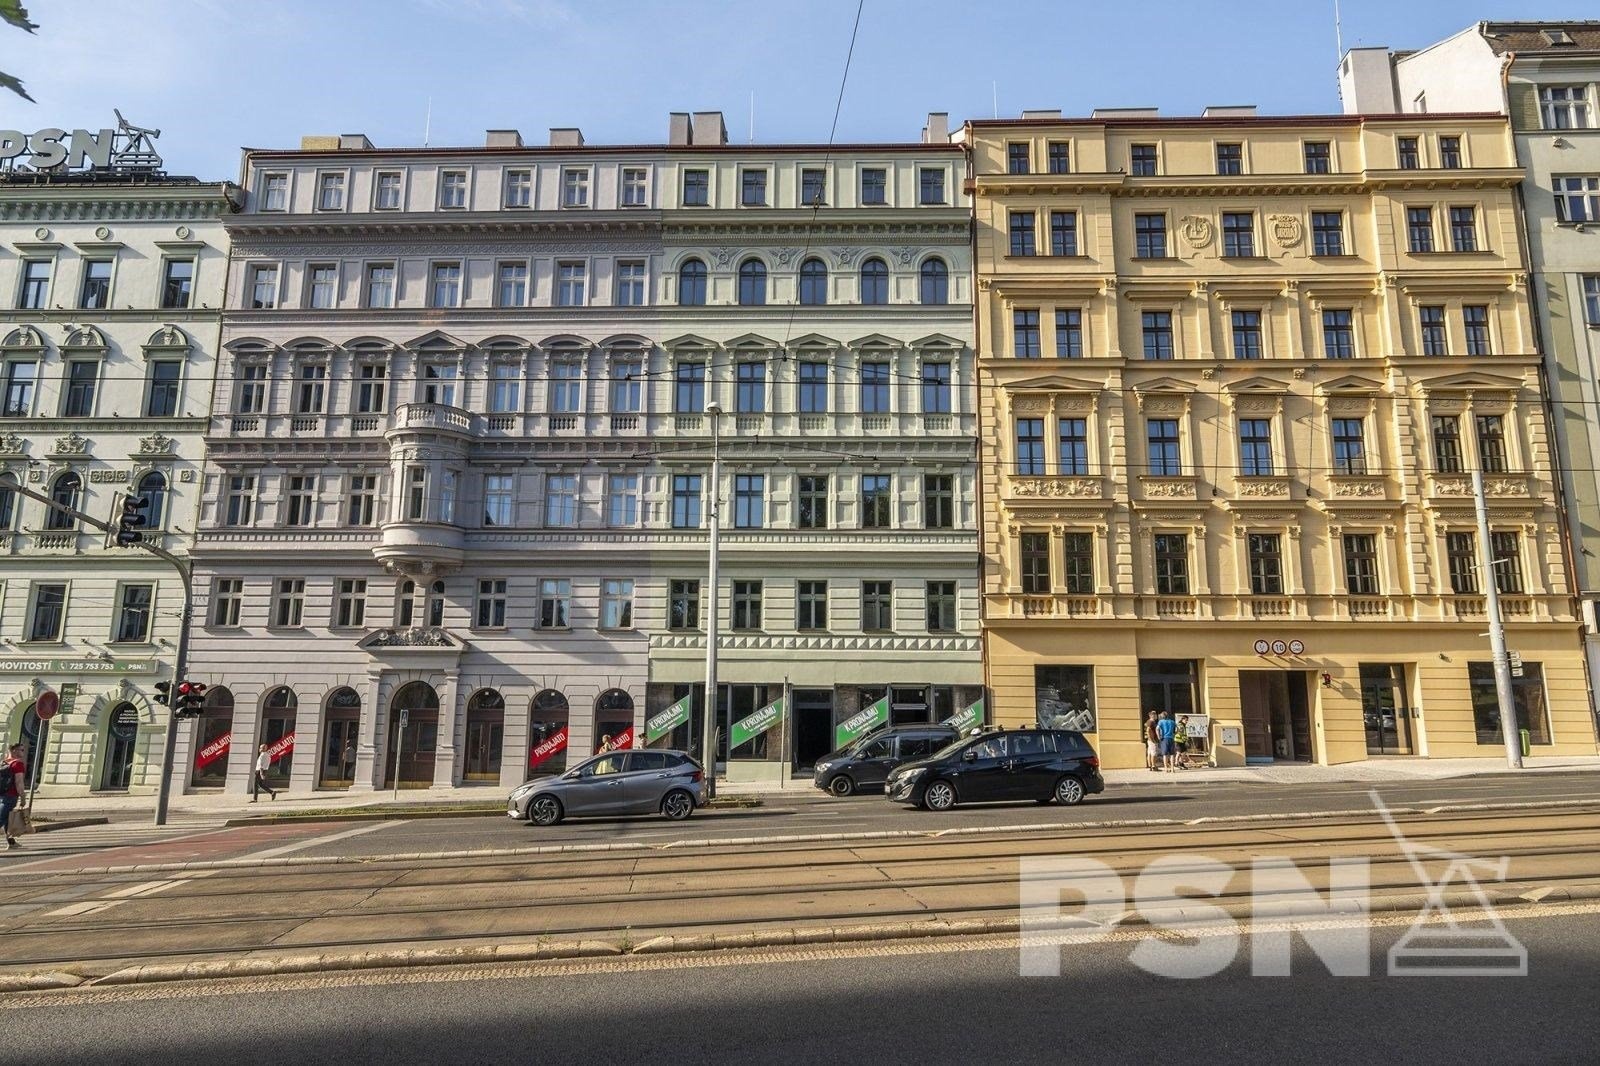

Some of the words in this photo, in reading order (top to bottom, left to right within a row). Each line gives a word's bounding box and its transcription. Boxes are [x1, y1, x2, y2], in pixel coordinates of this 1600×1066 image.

[0, 128, 114, 168] PSN
[649, 720, 656, 730] K
[741, 722, 748, 731] K
[843, 723, 851, 732] K
[200, 735, 232, 759] PRONAJATO
[266, 735, 296, 757] RONAJATO
[534, 732, 566, 757] PRONAJATO
